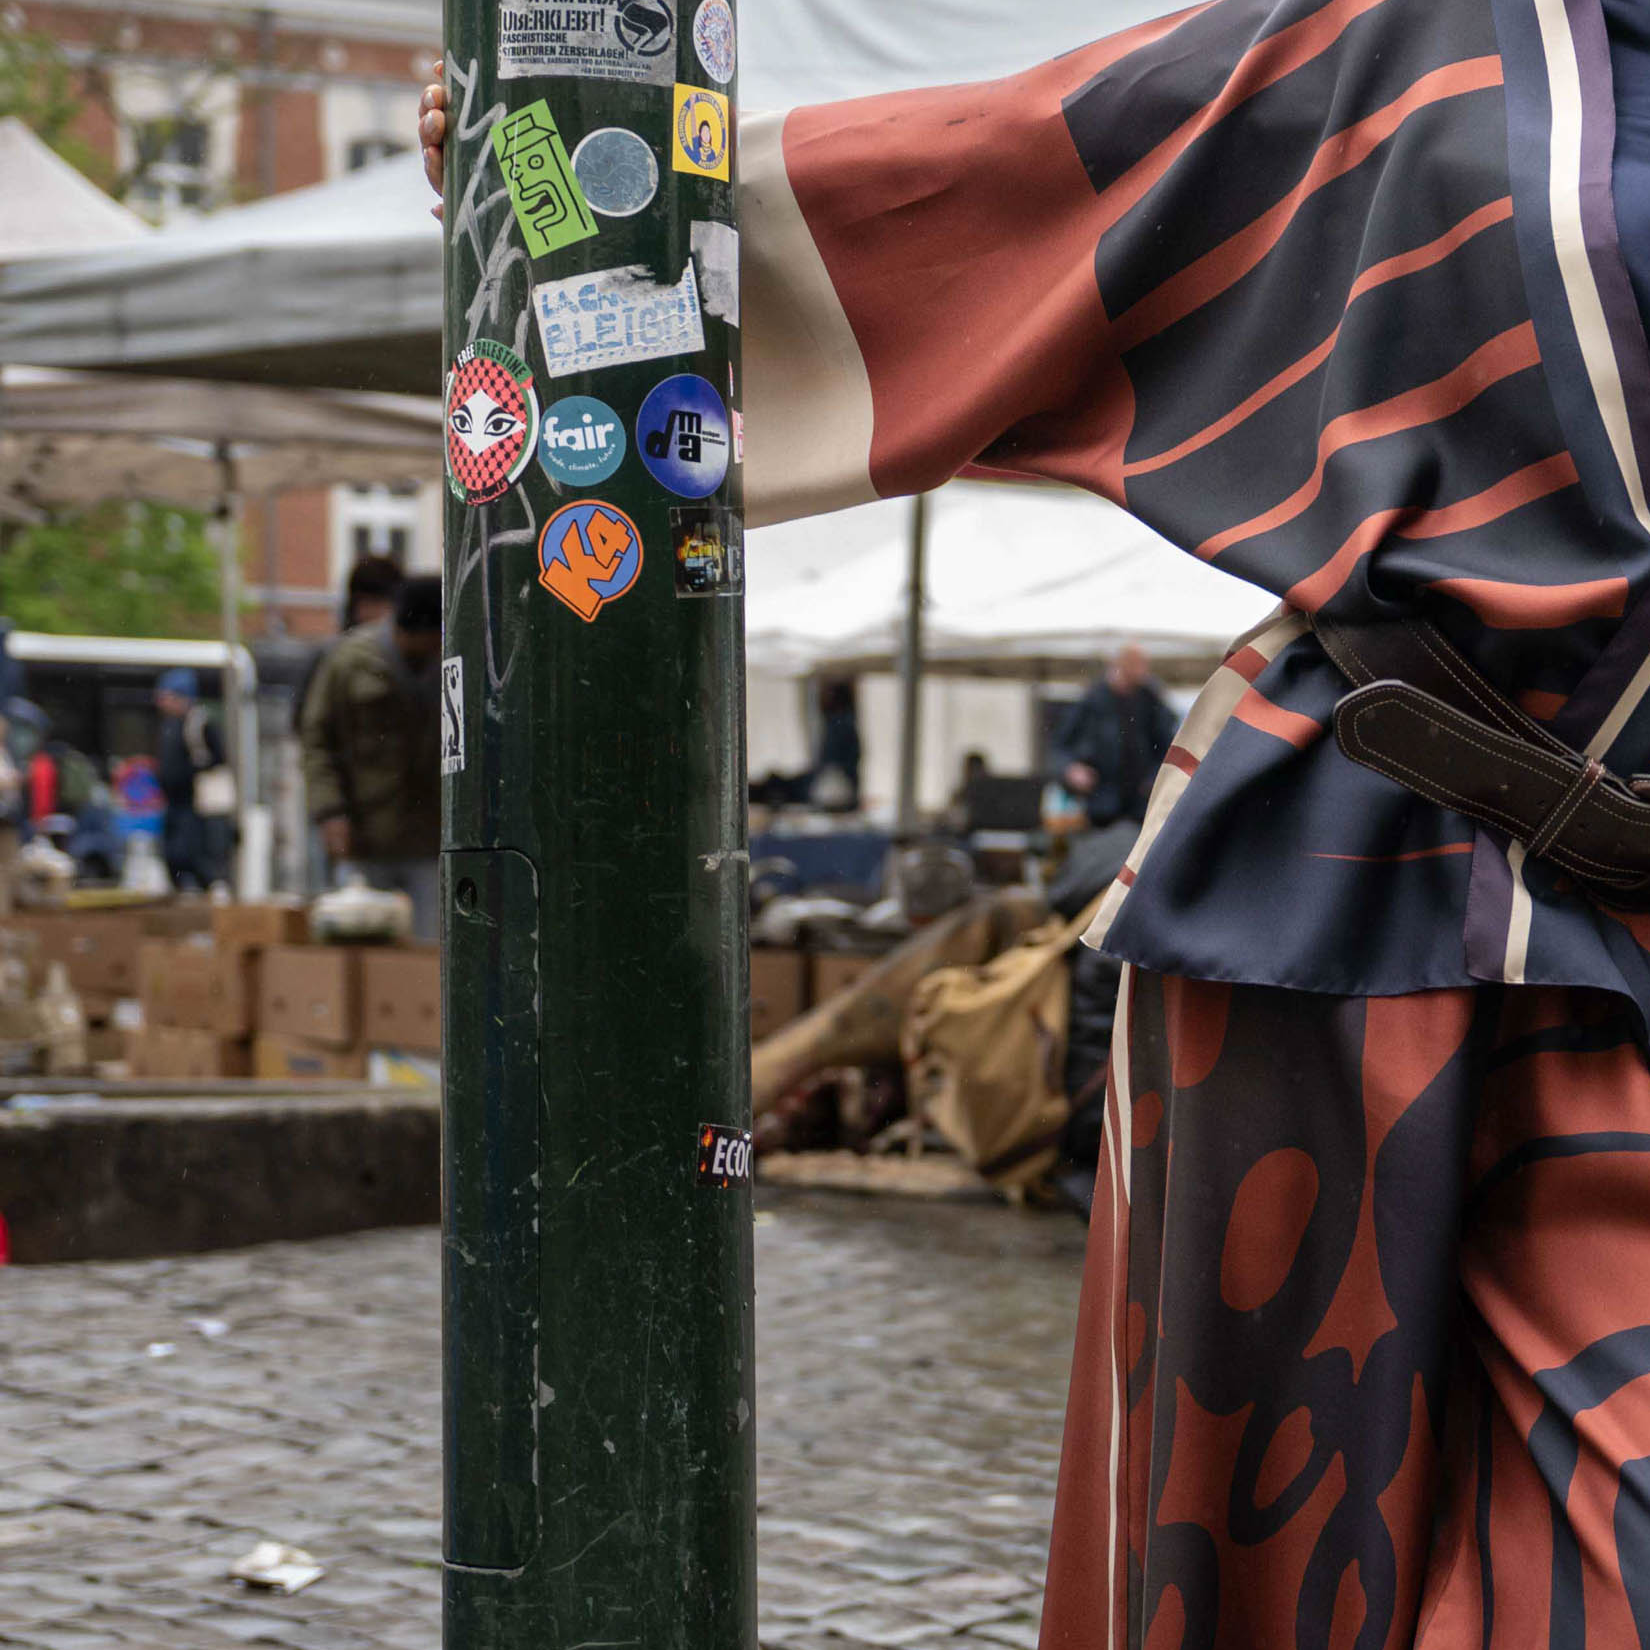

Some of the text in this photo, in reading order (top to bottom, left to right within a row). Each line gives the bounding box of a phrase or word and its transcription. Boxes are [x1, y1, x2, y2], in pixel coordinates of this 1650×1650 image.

[457, 340, 527, 379] FREE PALESTINE
[543, 413, 616, 451] fair
[541, 509, 633, 620] K4
